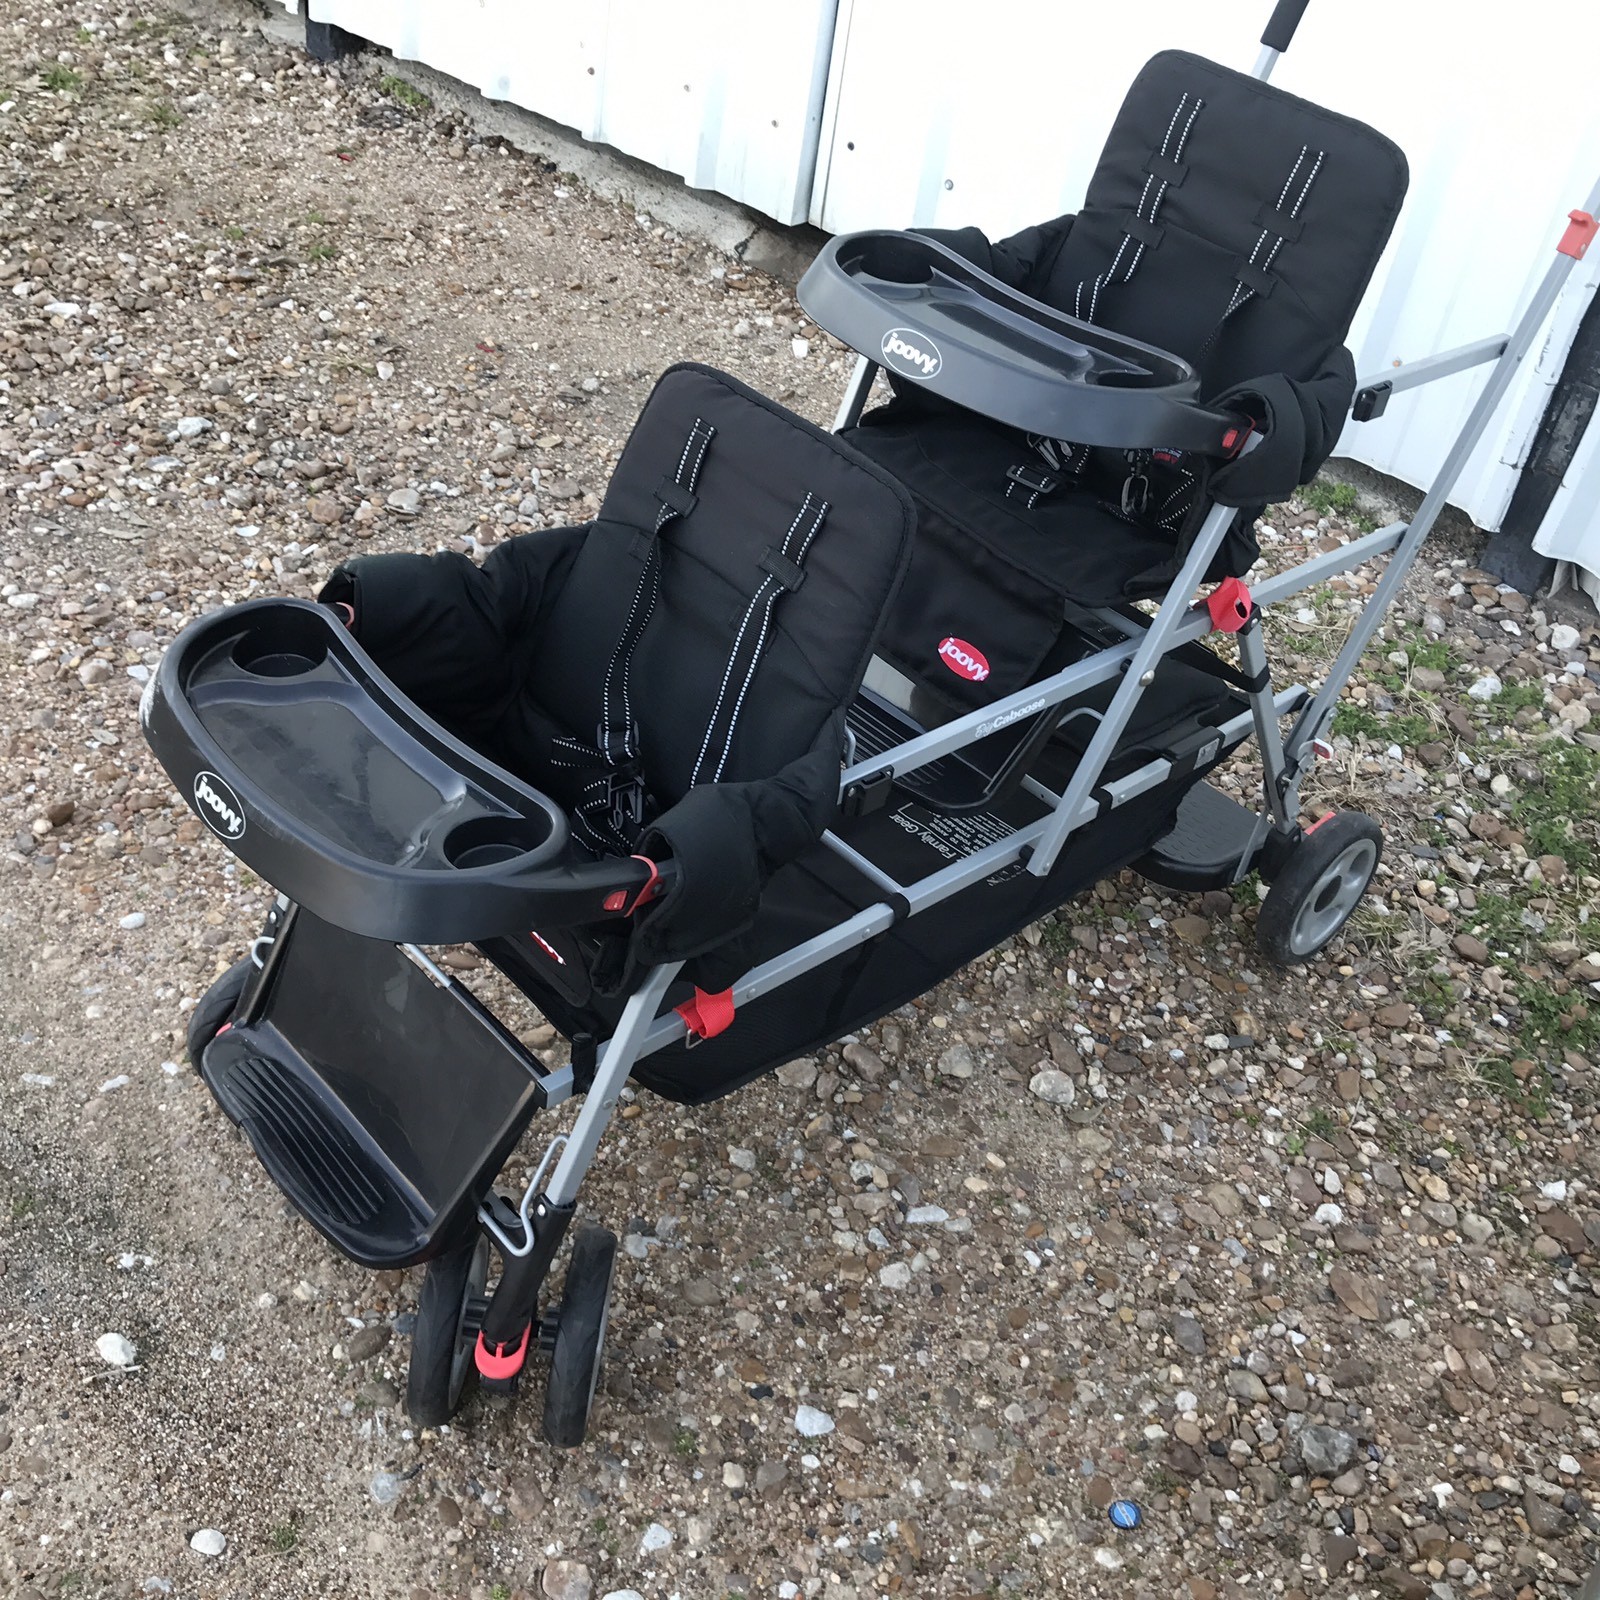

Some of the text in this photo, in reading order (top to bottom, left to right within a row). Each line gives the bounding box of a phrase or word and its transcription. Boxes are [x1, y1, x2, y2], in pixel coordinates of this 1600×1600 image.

[884, 331, 938, 374] joovy
[938, 637, 989, 680] joovy
[993, 698, 1046, 727] Caboose
[196, 774, 242, 833] joovy
[889, 814, 956, 859] Family Gear
[929, 822, 949, 836] AVOID
